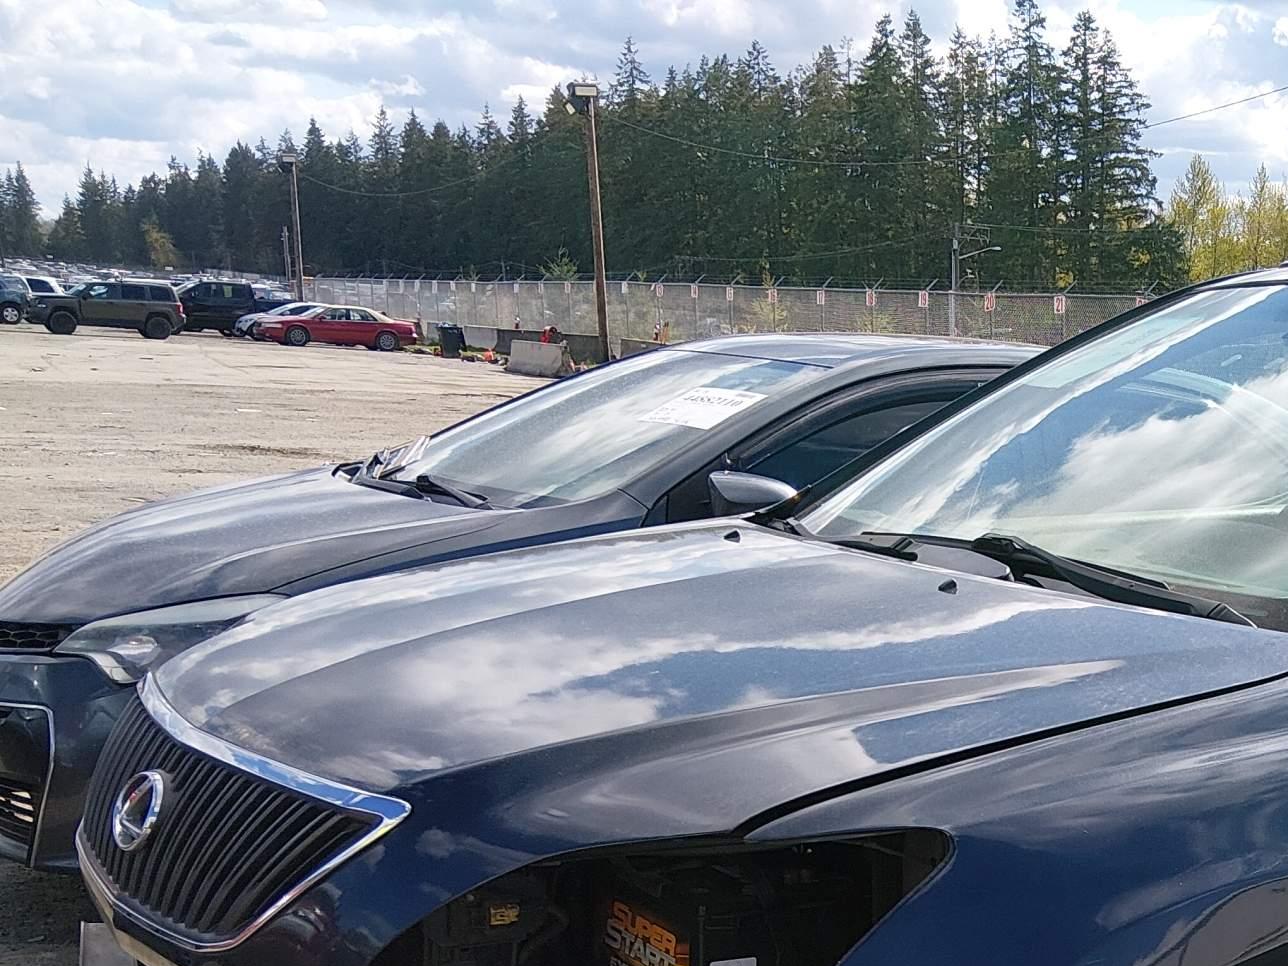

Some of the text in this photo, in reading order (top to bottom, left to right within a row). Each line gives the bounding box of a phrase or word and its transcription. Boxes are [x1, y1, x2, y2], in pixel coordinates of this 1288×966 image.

[920, 292, 927, 306] 19
[985, 295, 994, 311] 20
[1056, 297, 1063, 312] 21
[612, 900, 677, 957] SUPER
